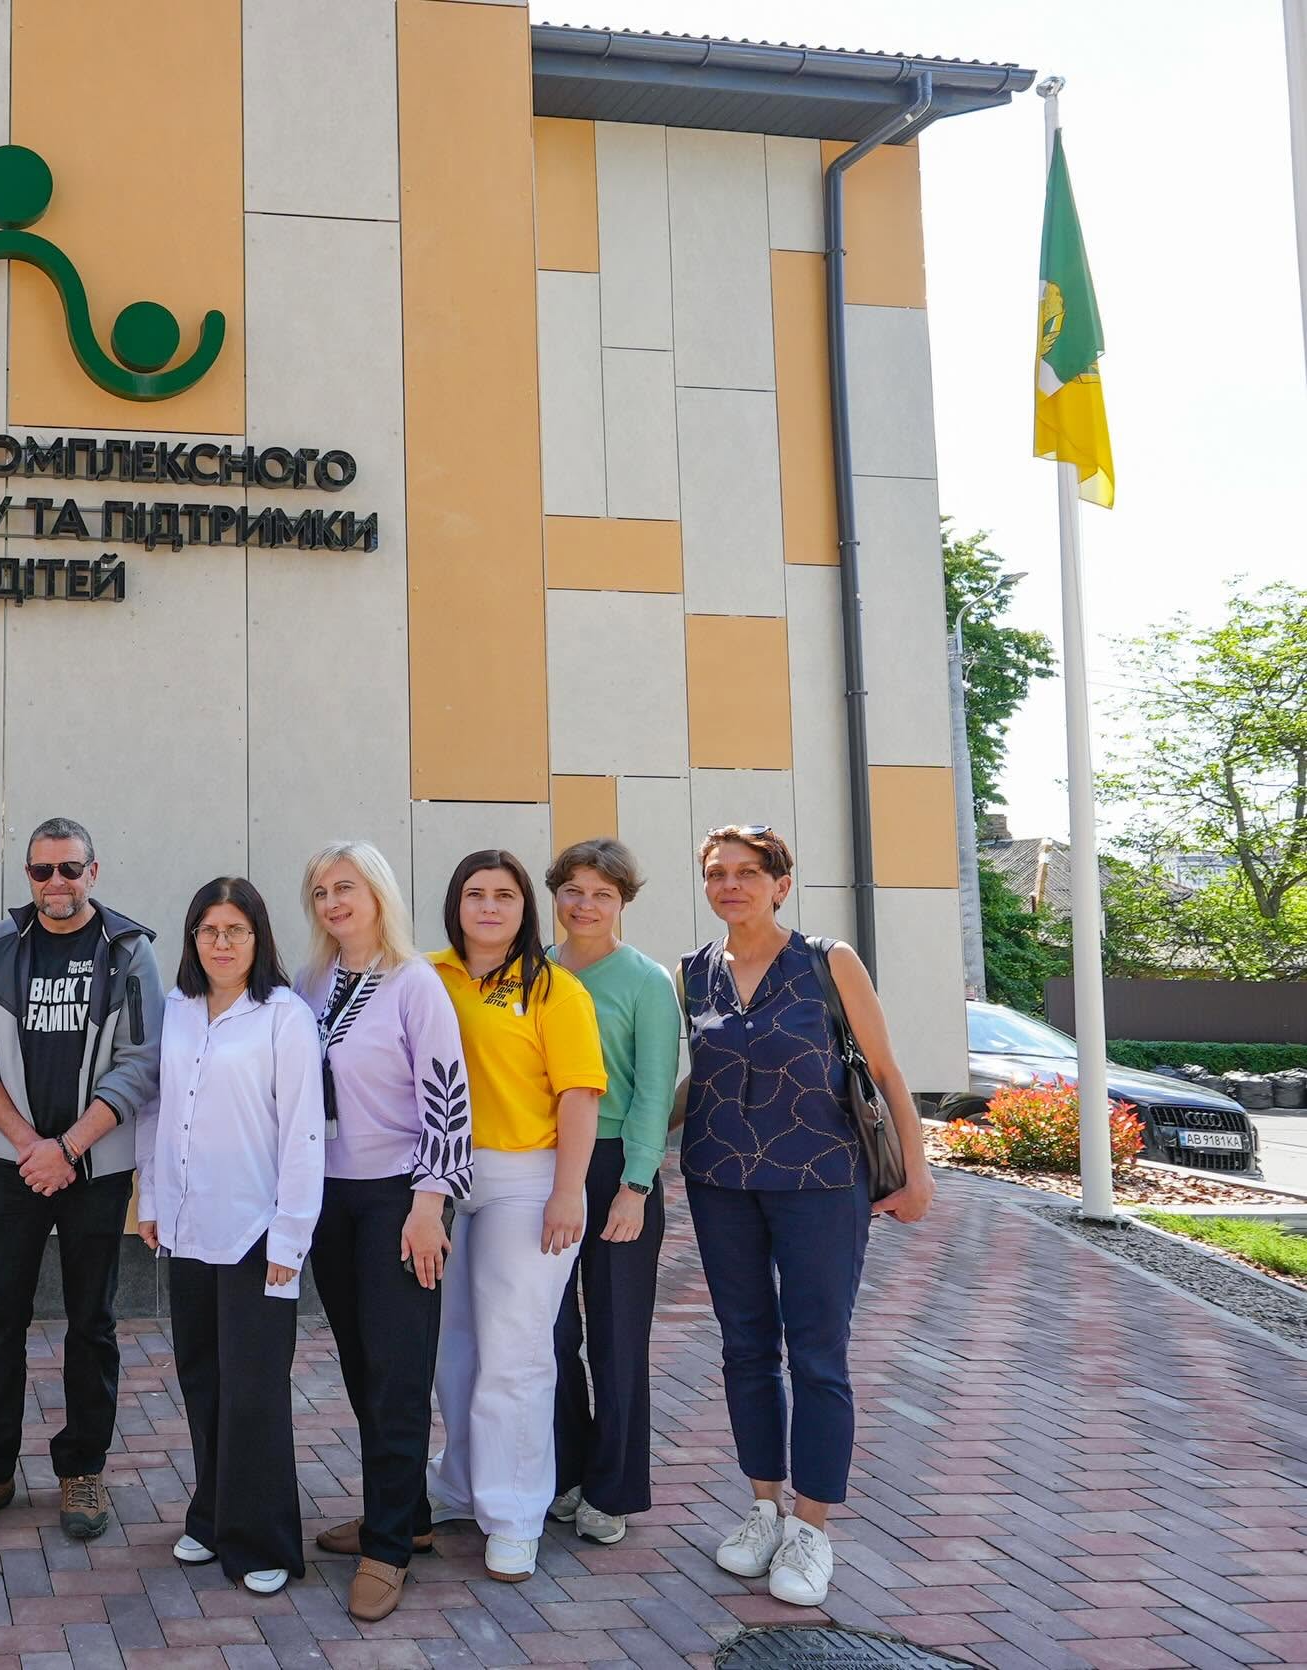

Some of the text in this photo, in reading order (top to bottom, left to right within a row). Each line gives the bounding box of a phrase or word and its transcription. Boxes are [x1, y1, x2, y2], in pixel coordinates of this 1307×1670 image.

[27, 497, 90, 541] ТА
[101, 500, 379, 553] ПІДТРИМКИ
[29, 976, 92, 1004] BACK T
[26, 1004, 89, 1032] FAMILY
